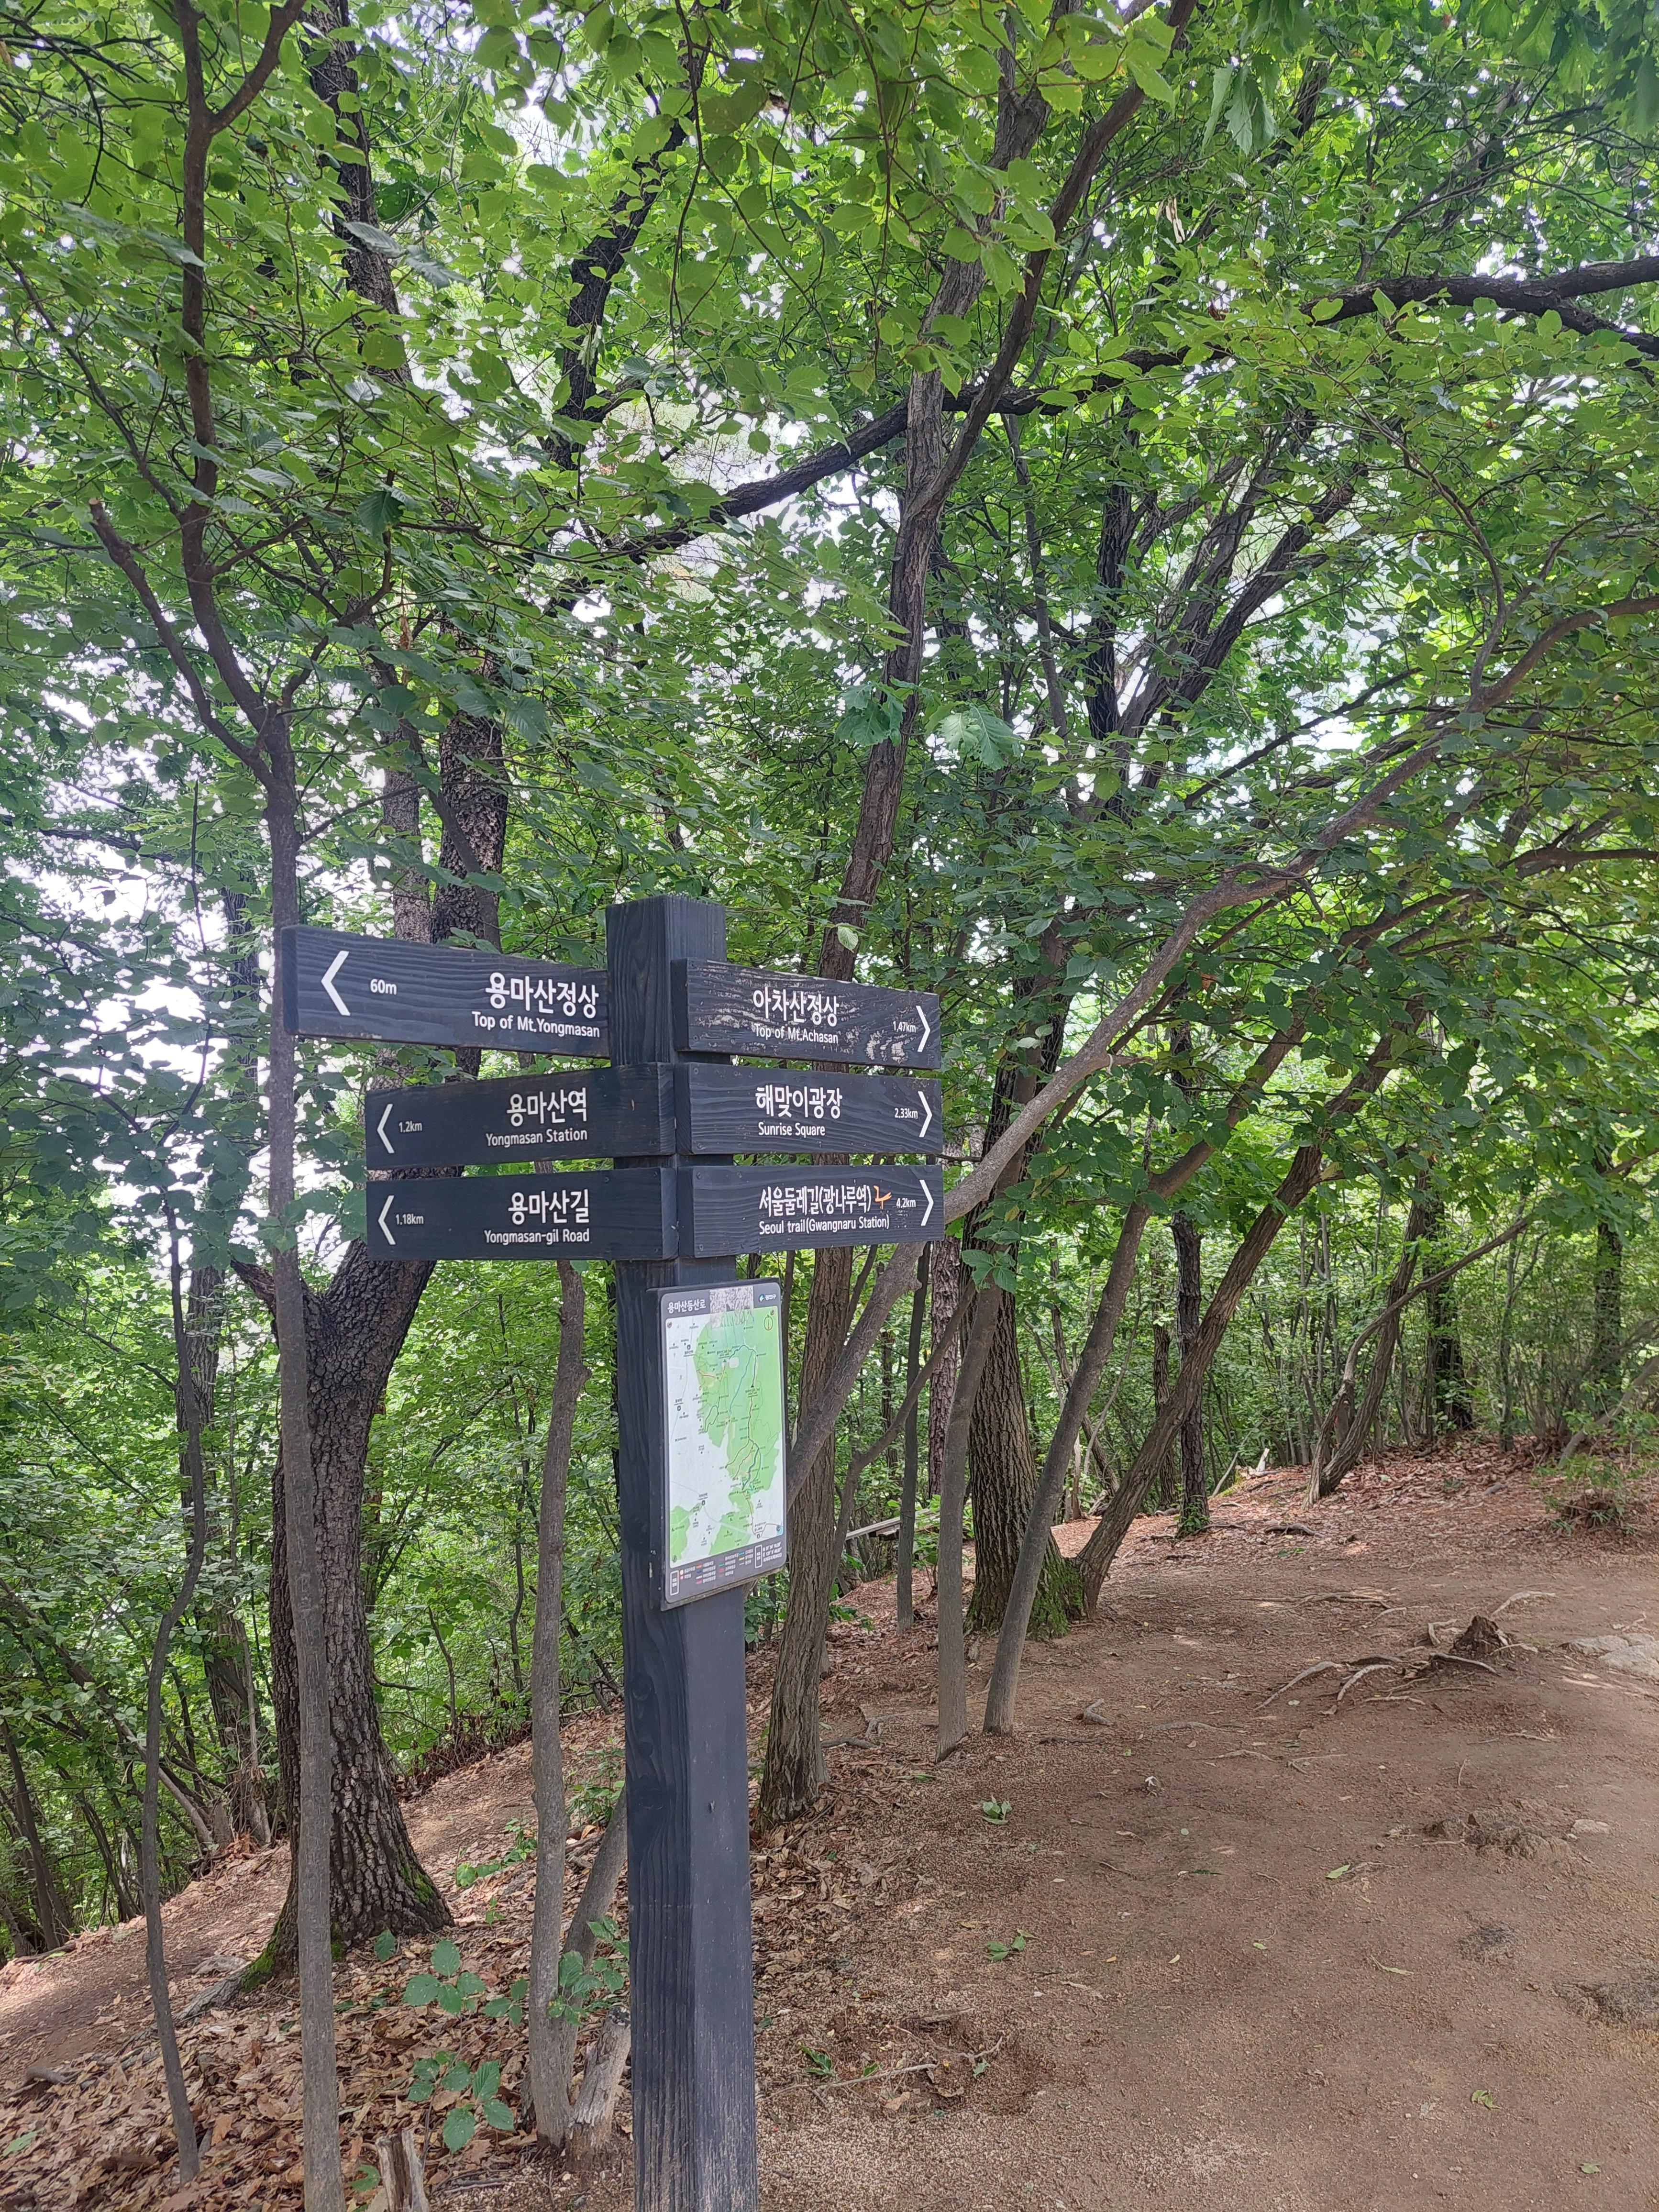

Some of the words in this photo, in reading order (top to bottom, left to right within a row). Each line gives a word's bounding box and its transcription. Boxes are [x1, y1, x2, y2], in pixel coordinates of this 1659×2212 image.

[370, 978, 397, 995] 60m
[486, 972, 599, 1018] 용마산정상
[753, 986, 839, 1027] 아차산정상
[472, 1011, 496, 1030] Top
[499, 1014, 513, 1029] of
[517, 1017, 600, 1038] Mt.Yongmasan
[893, 1021, 917, 1033] 1.47km
[755, 1024, 771, 1040] Top
[774, 1027, 785, 1039] of
[788, 1028, 838, 1044] Mt.Achasan
[507, 1087, 588, 1127] 용마산역
[755, 1085, 842, 1119] 해맞이광장
[895, 1108, 918, 1119] 2.33km
[398, 1121, 422, 1133] 1.2km
[759, 1122, 792, 1136] Sunrise
[795, 1123, 825, 1137] Square
[486, 1132, 542, 1148] Yongmasan
[546, 1128, 587, 1142] Station
[508, 1189, 590, 1225] 용마산길
[759, 1185, 871, 1217] 서울둘레길(광나루역)
[896, 1198, 916, 1209] 4.2km
[396, 1214, 424, 1226] 1.18km
[759, 1221, 784, 1235] Seoul
[859, 1217, 889, 1229] Station)
[484, 1229, 559, 1245] Yongmasan-gil
[563, 1228, 590, 1243] Road
[667, 1298, 707, 1314] 용마산등산로
